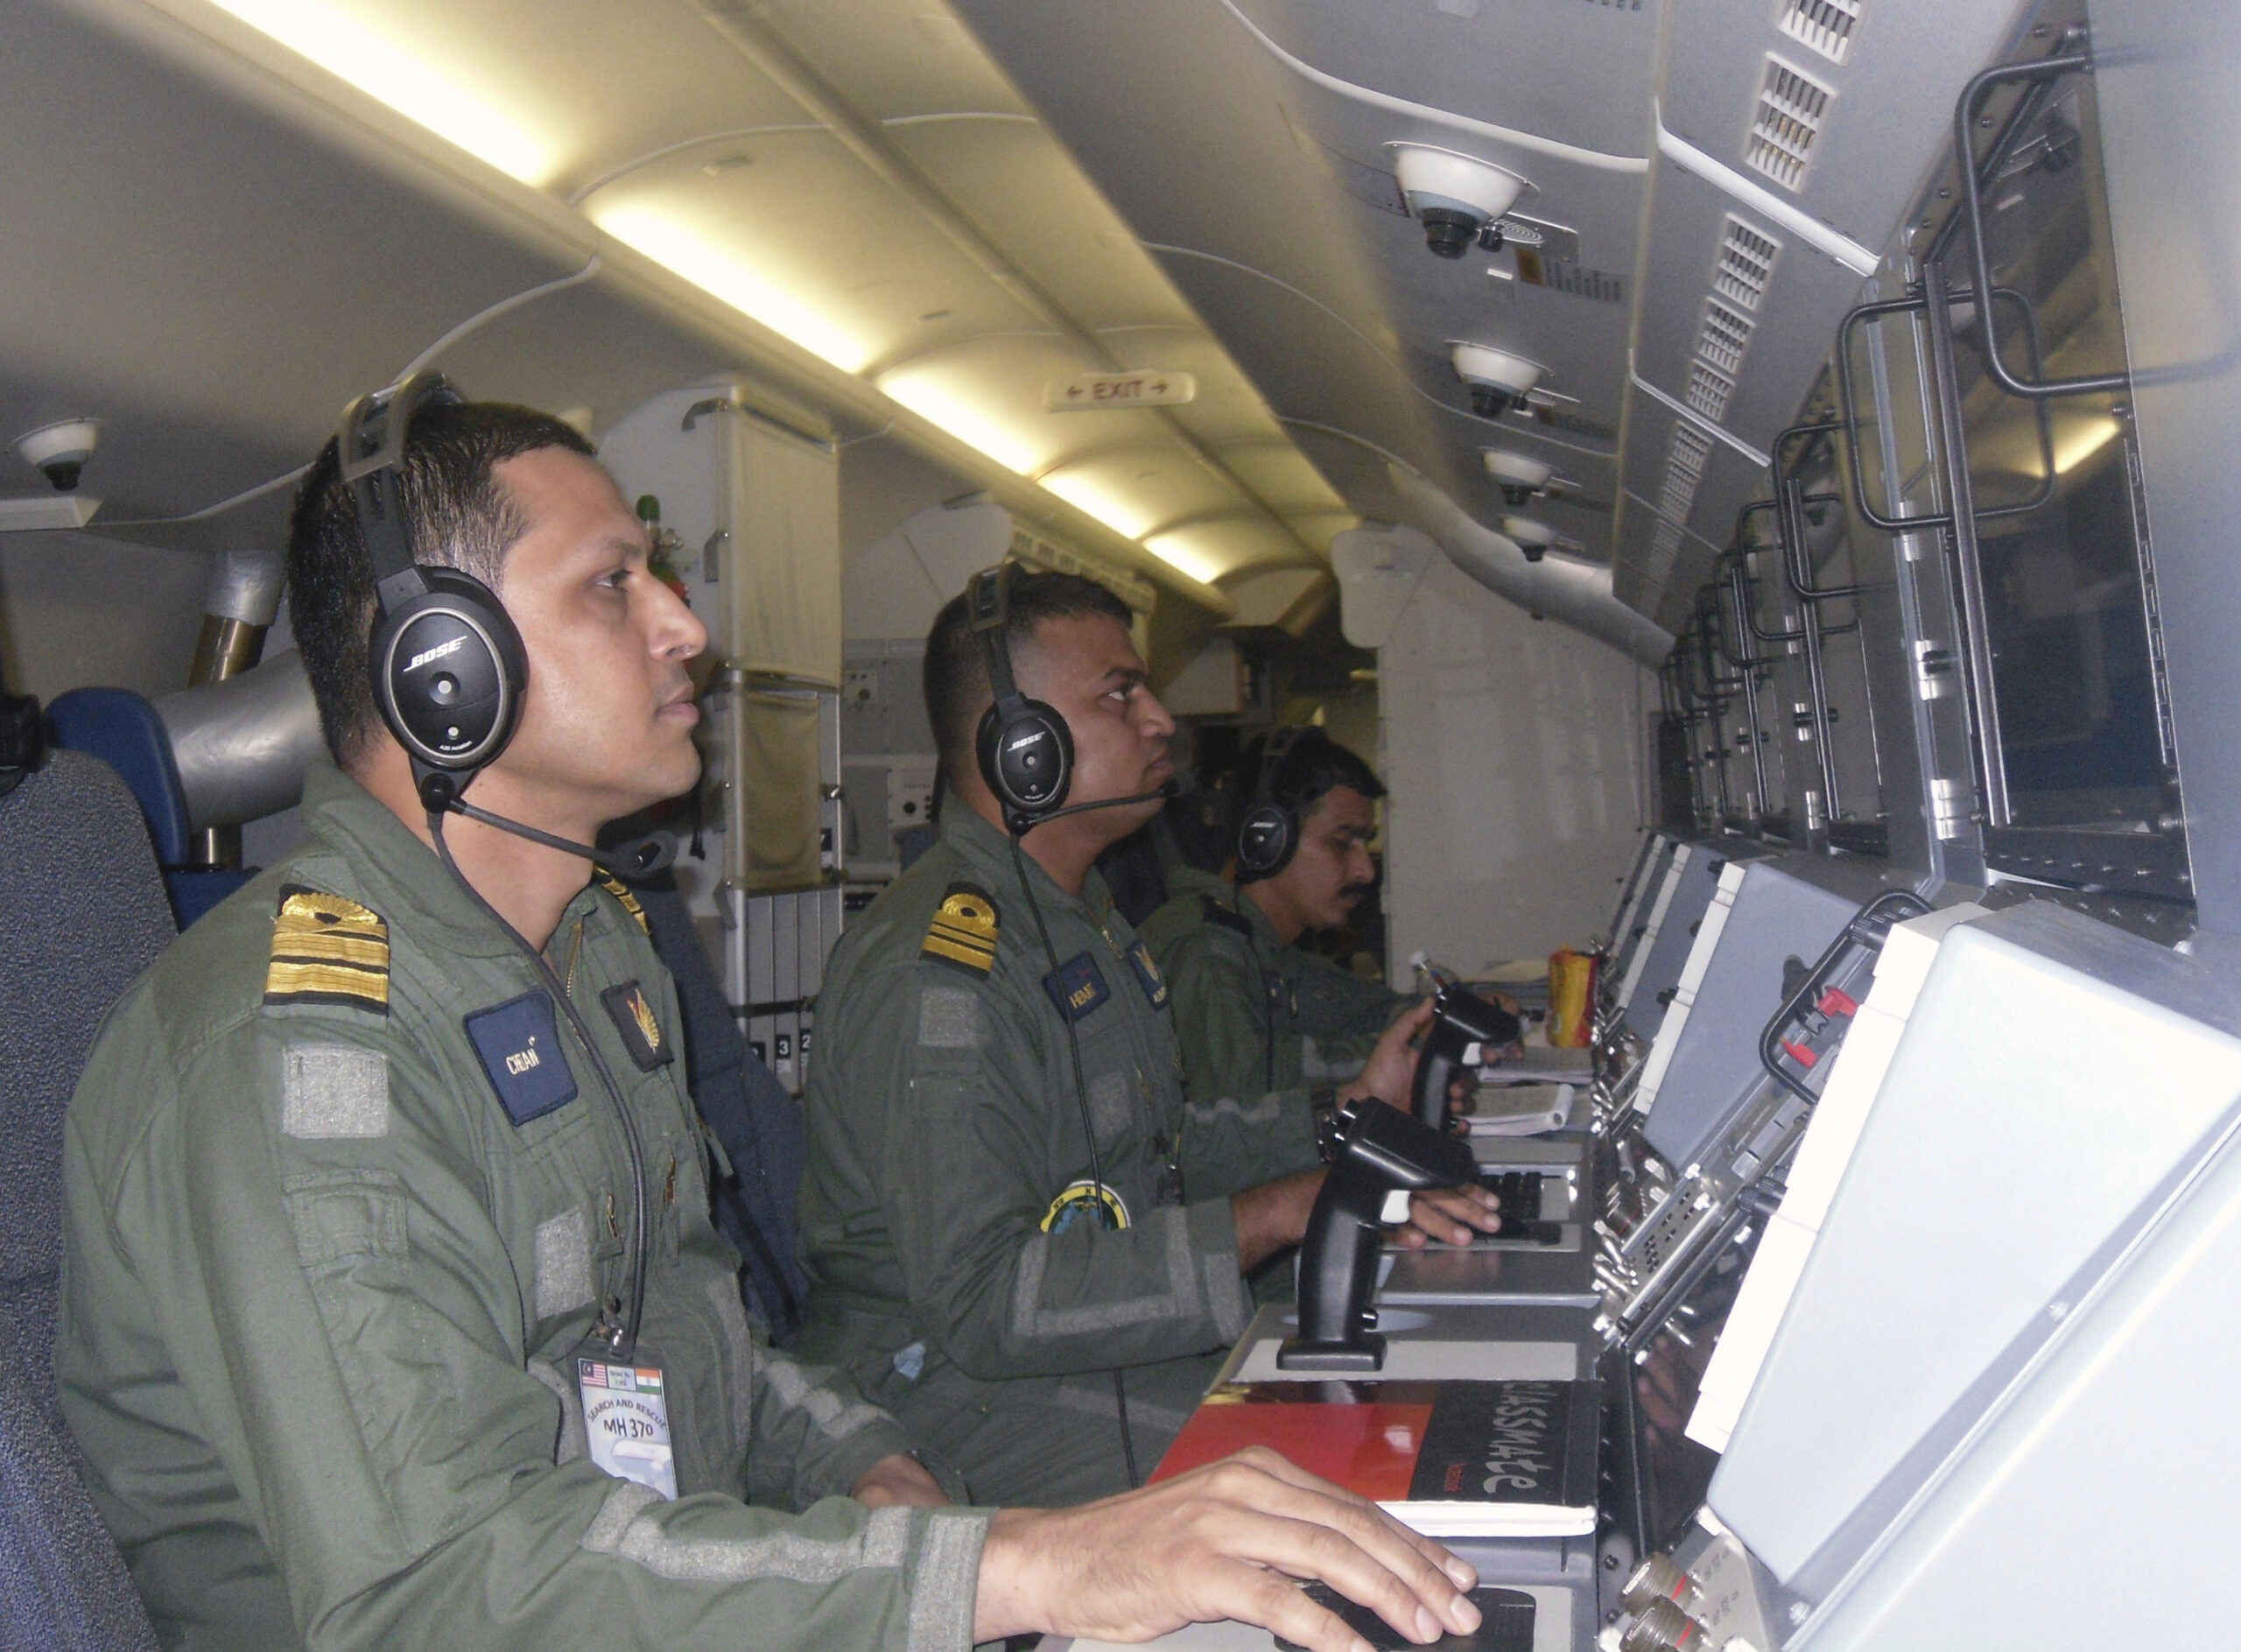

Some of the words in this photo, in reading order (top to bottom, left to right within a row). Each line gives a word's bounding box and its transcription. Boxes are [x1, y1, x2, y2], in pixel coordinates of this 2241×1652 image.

[1092, 380, 1143, 400] EXIT
[404, 636, 467, 672] BOSE
[778, 1040, 790, 1055] 3
[802, 1034, 811, 1049] 2
[587, 1400, 614, 1423] SEARCH
[615, 1399, 634, 1409] AND
[636, 1402, 667, 1430] RESCUE
[603, 1418, 628, 1438] MH
[629, 1419, 654, 1438] 370
